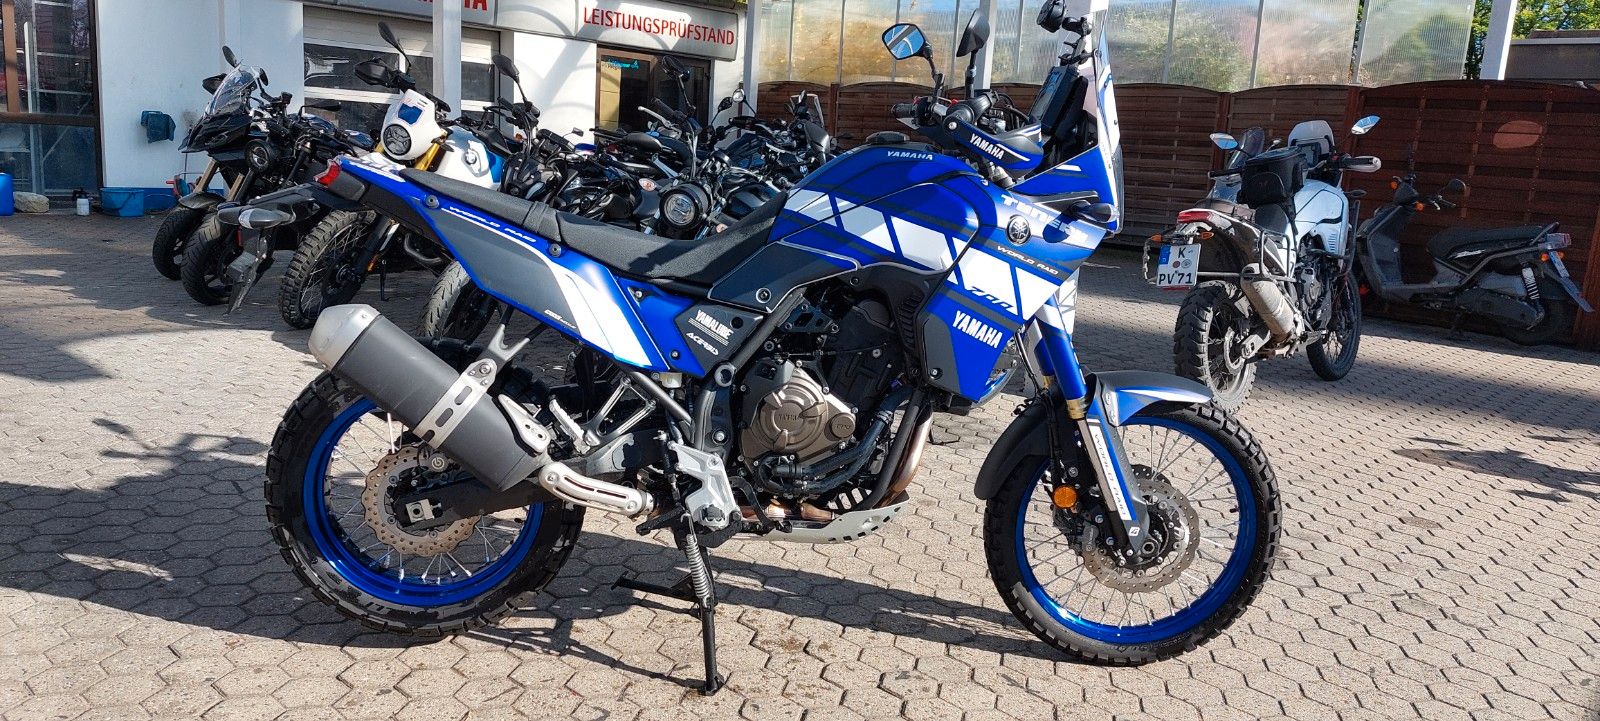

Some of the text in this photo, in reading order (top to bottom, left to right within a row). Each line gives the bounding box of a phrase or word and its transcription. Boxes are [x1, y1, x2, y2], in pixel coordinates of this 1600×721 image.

[583, 7, 735, 46] LEISTUNGSPRÜFSTAND
[887, 150, 933, 161] YAMAHA
[970, 133, 1005, 160] YAMAHA
[449, 206, 537, 243] WORLD RAID
[997, 245, 1059, 275] WORLD RAID
[1178, 246, 1187, 259] K
[695, 309, 734, 340] YAMALUBE
[952, 310, 1003, 349] YAMAHA
